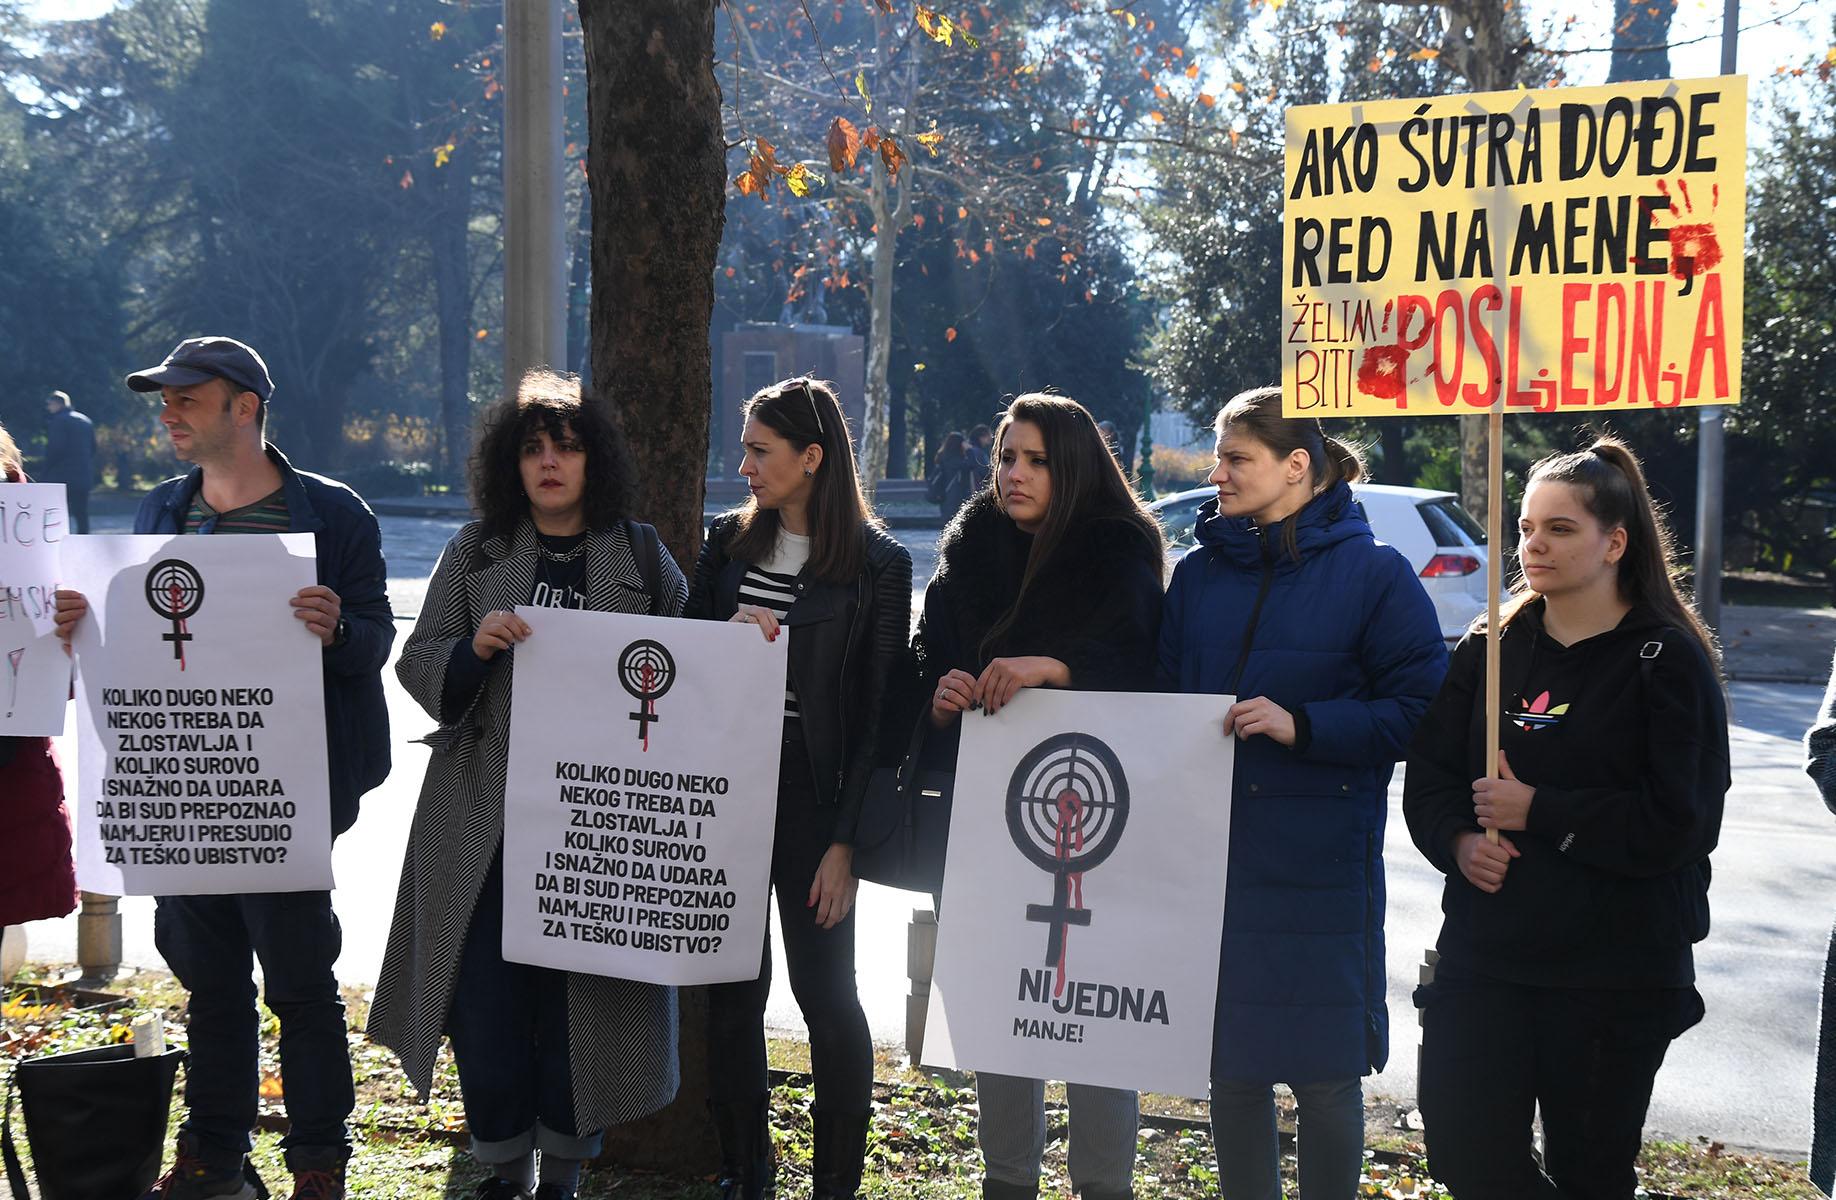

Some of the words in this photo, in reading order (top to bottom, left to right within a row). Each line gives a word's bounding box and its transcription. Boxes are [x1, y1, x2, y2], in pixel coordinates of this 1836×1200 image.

[1290, 123, 1379, 199] AKO
[1398, 104, 1541, 193] ŚUTRA
[1560, 93, 1720, 181] DOĐE
[1293, 215, 1391, 288] RED
[1415, 208, 1493, 281] NA
[1510, 195, 1694, 296] MENE,
[1289, 295, 1376, 344] ŽELIM
[1296, 350, 1353, 409] BITI
[103, 688, 162, 706] KOLIKO
[166, 689, 217, 706] DUGO
[221, 688, 273, 706] NEKO
[107, 711, 166, 729] NEKOG
[169, 712, 232, 729] TREBA
[237, 711, 264, 729] DA
[118, 734, 239, 752] ZLOSTAVLJA
[246, 734, 252, 751] I
[114, 757, 180, 774] KOLIKO
[184, 757, 259, 774] SUROVO
[556, 762, 620, 784] KOLIKO
[624, 769, 673, 790] DUGO
[677, 774, 728, 795] NEKO
[107, 776, 183, 797] SNAŽNO
[186, 780, 213, 797] DA
[216, 779, 285, 797] UDARA
[560, 785, 620, 807] NEKOG
[625, 792, 685, 814] TREBA
[689, 798, 715, 817] DA
[97, 801, 116, 819] DA
[118, 802, 136, 819] BI
[139, 802, 177, 819] SUD
[180, 801, 296, 819] PREPOZNAO
[569, 809, 687, 838] ZLOSTAVLJA
[696, 822, 701, 839] I
[100, 824, 185, 842] NAMJERU
[189, 825, 194, 842] I
[198, 824, 292, 842] PRESUDIO
[565, 831, 628, 854] KOLIKO
[632, 839, 706, 862] SUROVO
[105, 846, 127, 864] ZA
[129, 843, 191, 865] TEŠKO
[194, 847, 288, 864] UBISTVO?
[546, 852, 550, 868] I
[554, 852, 628, 878] SNAŽNO
[632, 862, 655, 881] DA
[660, 865, 727, 886] UDARA
[536, 873, 559, 892] DA
[563, 877, 580, 895] BI
[584, 879, 619, 899] SUD
[623, 884, 736, 908] PREPOZNAO
[539, 896, 624, 923] NAMJERU
[628, 907, 633, 924] I
[637, 909, 729, 931] PRESUDIO
[543, 919, 566, 938] ZA
[570, 922, 627, 946] TEŠKO
[631, 931, 722, 953] UBISTVO?
[1013, 1018, 1083, 1043] MANJE!
